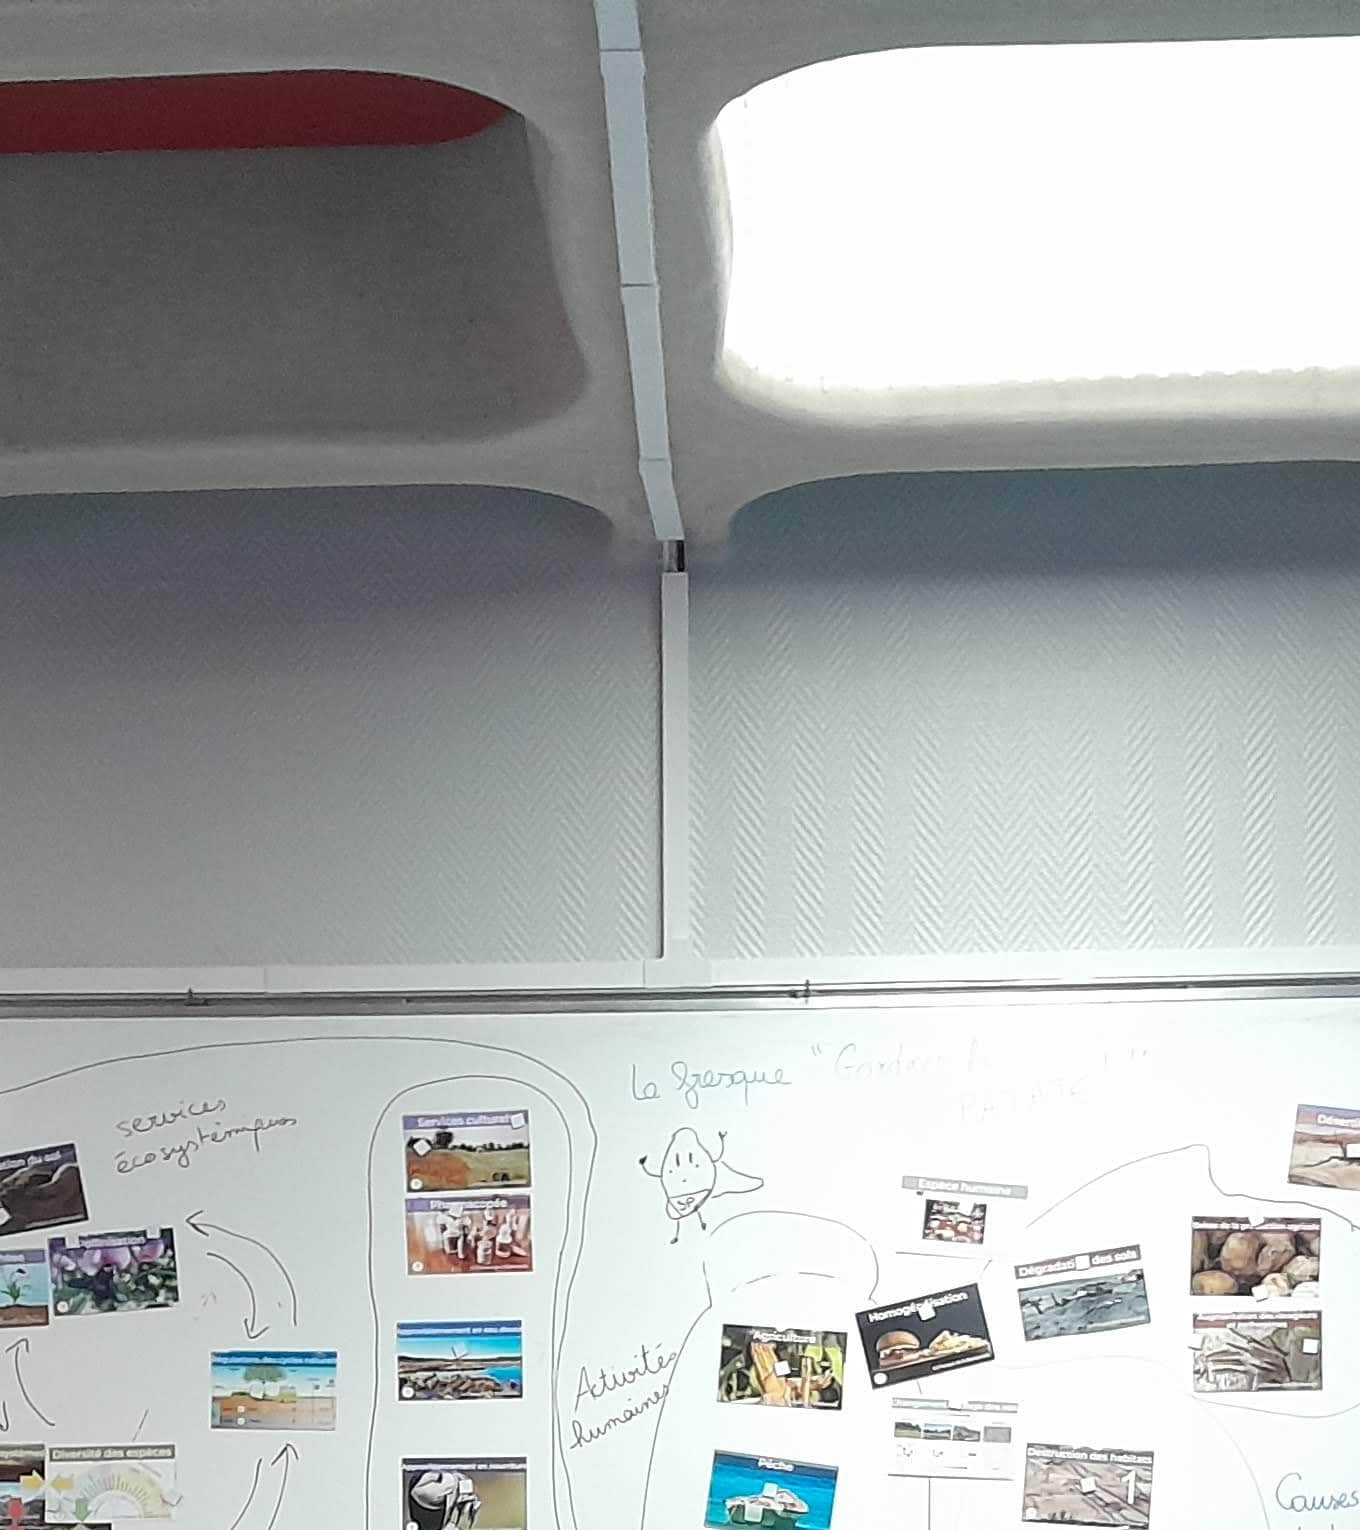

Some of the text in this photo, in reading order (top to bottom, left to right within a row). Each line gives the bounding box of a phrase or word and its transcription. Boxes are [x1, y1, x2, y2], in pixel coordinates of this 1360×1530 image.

[115, 1099, 227, 1138] services
[574, 1342, 678, 1414] Activités
[569, 1383, 670, 1450] humaines
[51, 1448, 102, 1461] Diversité
[103, 1448, 125, 1460] des
[1120, 1469, 1137, 1505] 1
[1274, 1471, 1360, 1513] Causes
